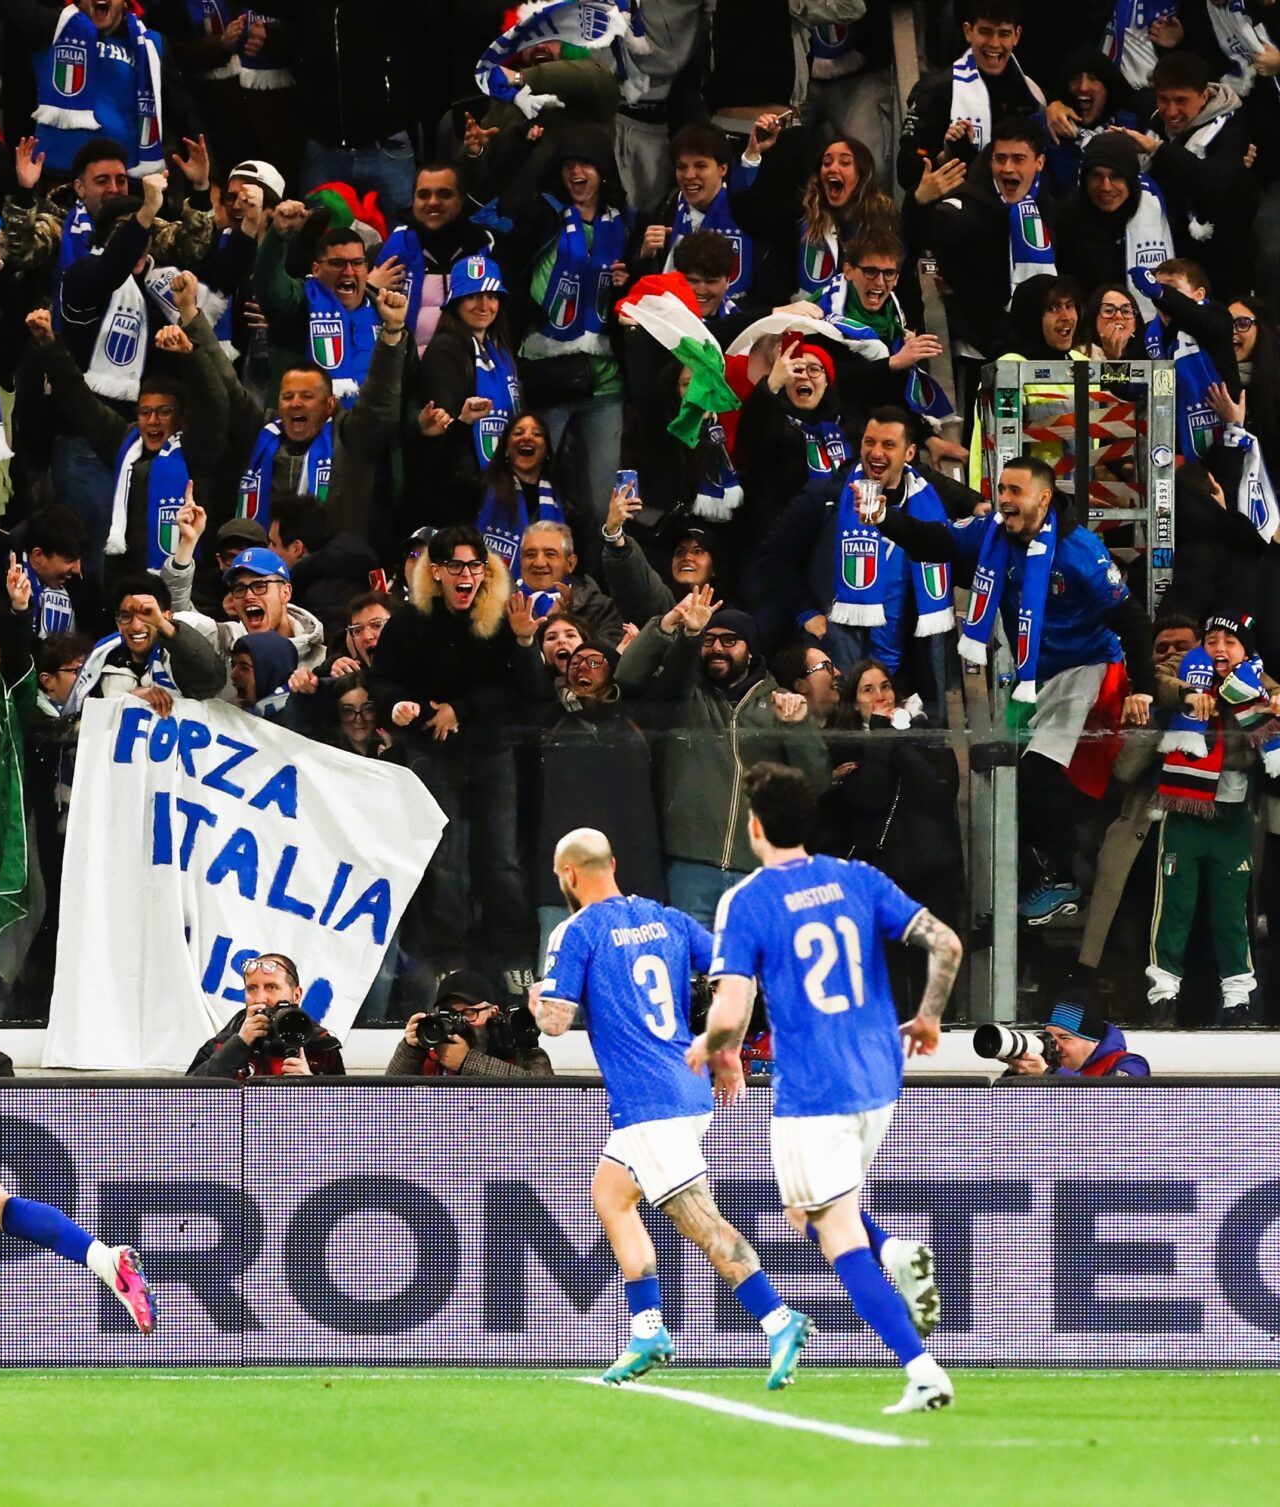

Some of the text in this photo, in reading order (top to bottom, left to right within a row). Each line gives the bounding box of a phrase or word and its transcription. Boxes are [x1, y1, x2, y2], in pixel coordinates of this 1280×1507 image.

[55, 49, 83, 61] ITALIA
[313, 324, 339, 336] ITALIA
[1100, 373, 1131, 382] Claudia
[318, 470, 330, 482] ITA
[161, 510, 176, 521] ITA
[485, 538, 513, 555] ITALIA
[844, 541, 873, 553] ITALIA
[1214, 617, 1238, 631] ITALIA
[113, 707, 298, 819] FORZA
[151, 791, 392, 946] ITALIA
[611, 921, 669, 947] DIMARCO
[793, 915, 865, 1015] 21
[633, 954, 677, 1021] 3
